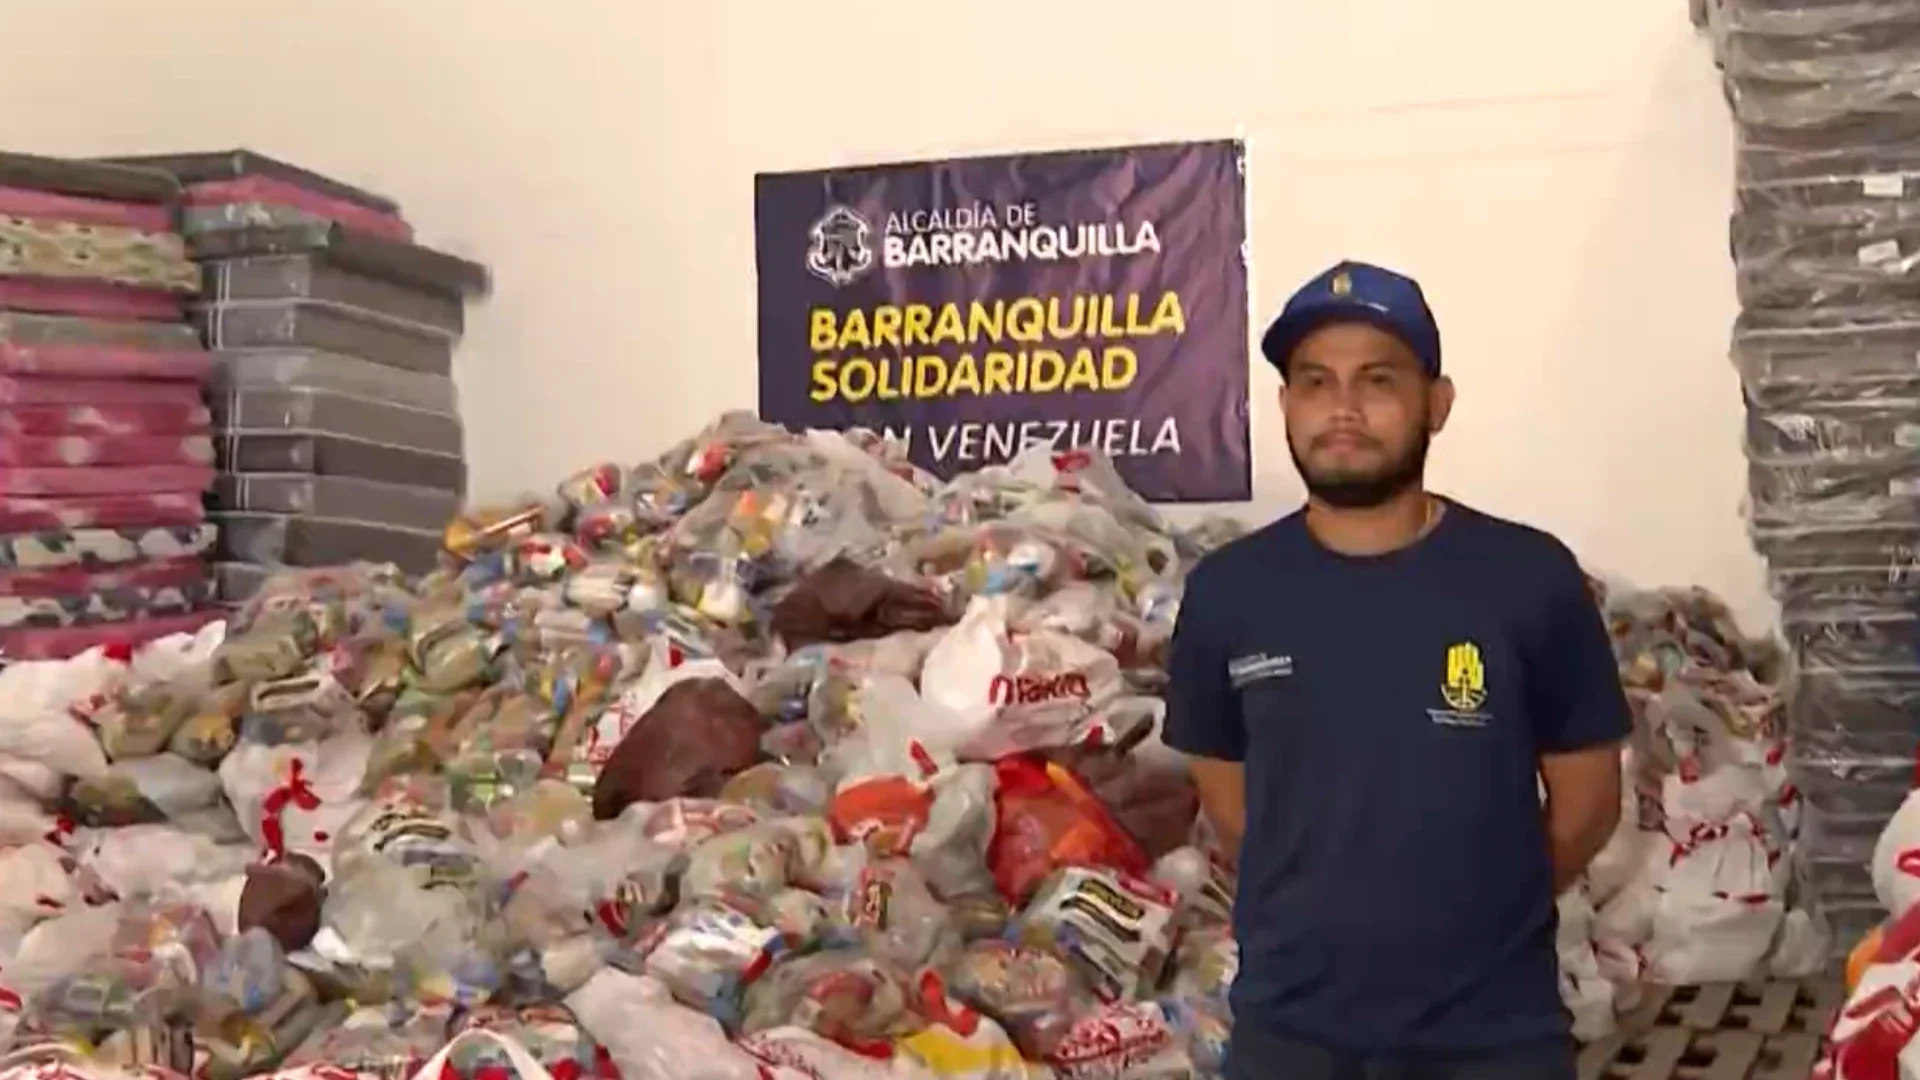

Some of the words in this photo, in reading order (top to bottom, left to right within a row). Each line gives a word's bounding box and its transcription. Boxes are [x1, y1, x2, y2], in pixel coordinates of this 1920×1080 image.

[884, 202, 998, 235] ALCALDÍA
[1005, 203, 1038, 227] DE
[884, 220, 1161, 268] BARRANQUILLA
[810, 291, 1186, 351] BARRANQUILLA
[810, 347, 1139, 401] SOLIDARIDAD
